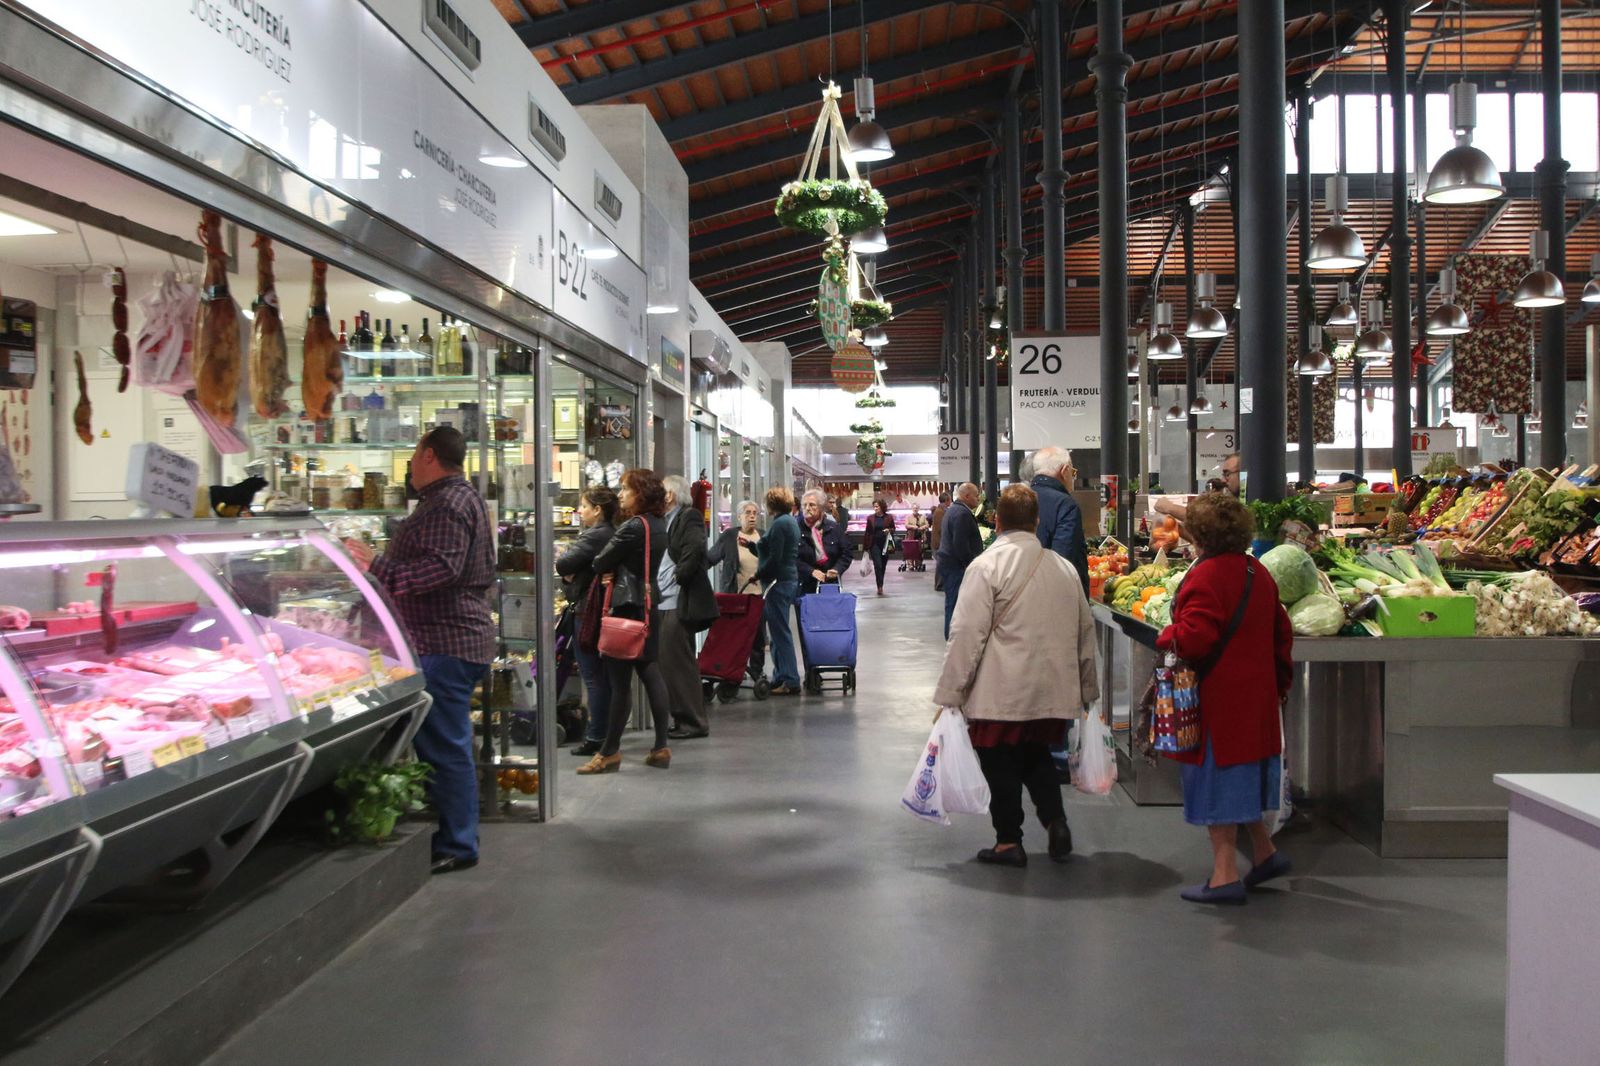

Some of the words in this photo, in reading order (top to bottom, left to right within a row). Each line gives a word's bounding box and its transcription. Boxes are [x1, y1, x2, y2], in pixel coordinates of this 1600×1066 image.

[559, 229, 587, 301] B-22
[1019, 344, 1062, 375] 26
[1019, 387, 1059, 397] FRUTERÍA
[1020, 401, 1045, 409] PACO
[1047, 400, 1086, 408] ANDUJAR
[940, 436, 960, 451] 30
